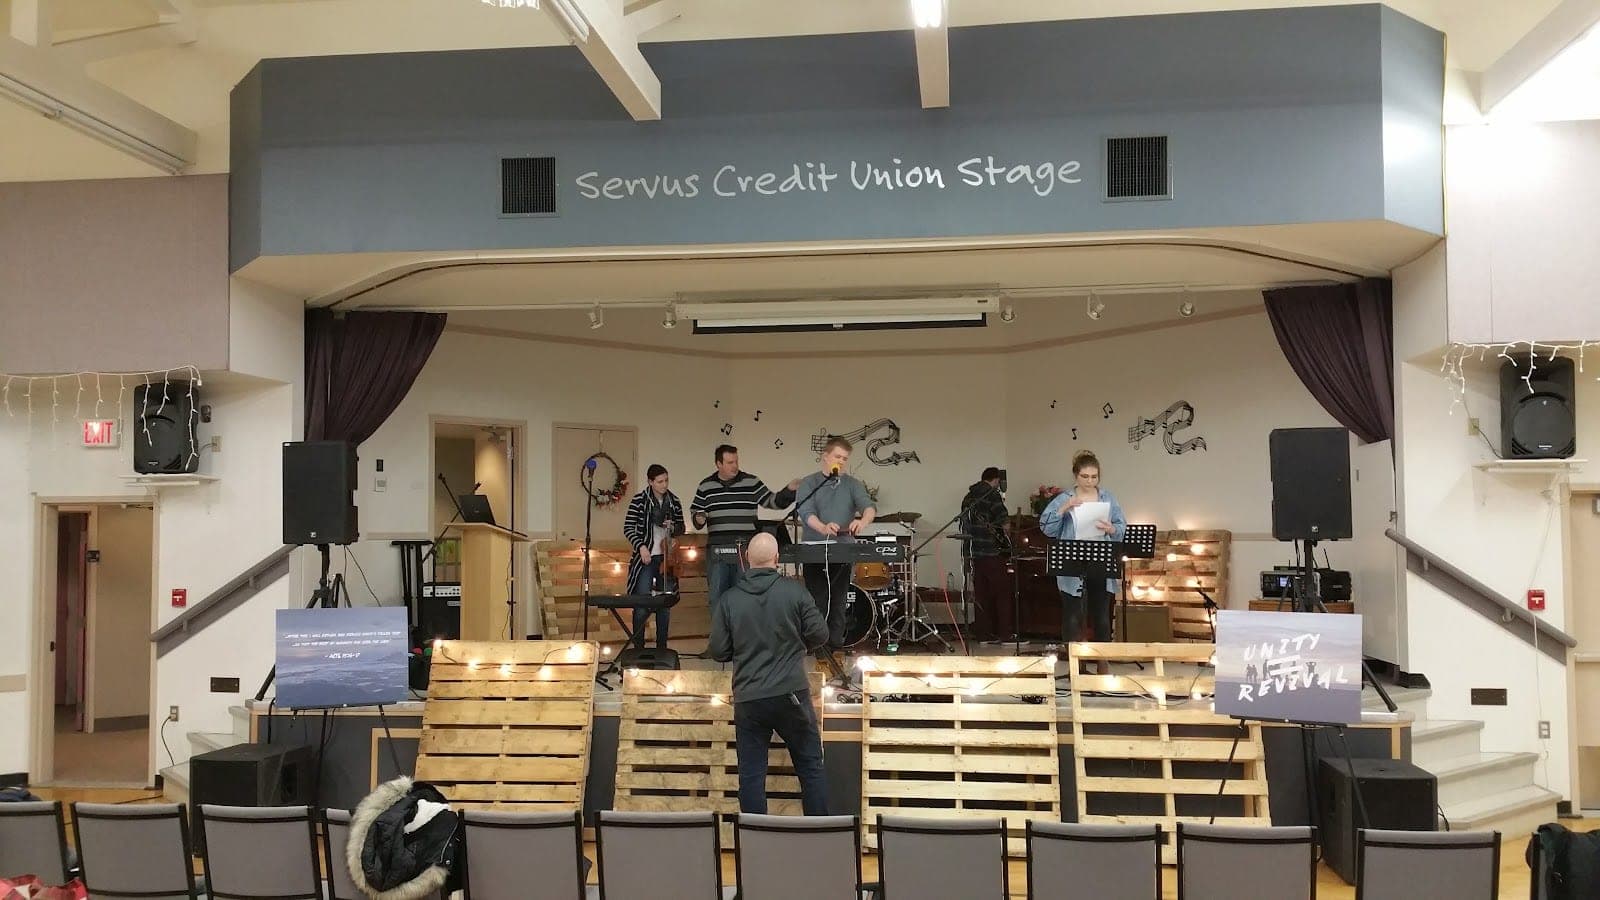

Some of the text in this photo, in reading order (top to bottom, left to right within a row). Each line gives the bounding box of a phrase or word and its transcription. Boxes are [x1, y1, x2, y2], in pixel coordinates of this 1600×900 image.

[576, 156, 1082, 199] Servus Credit Union Stage
[1243, 633, 1320, 661] UNITY
[1238, 665, 1348, 702] REVIVAL
